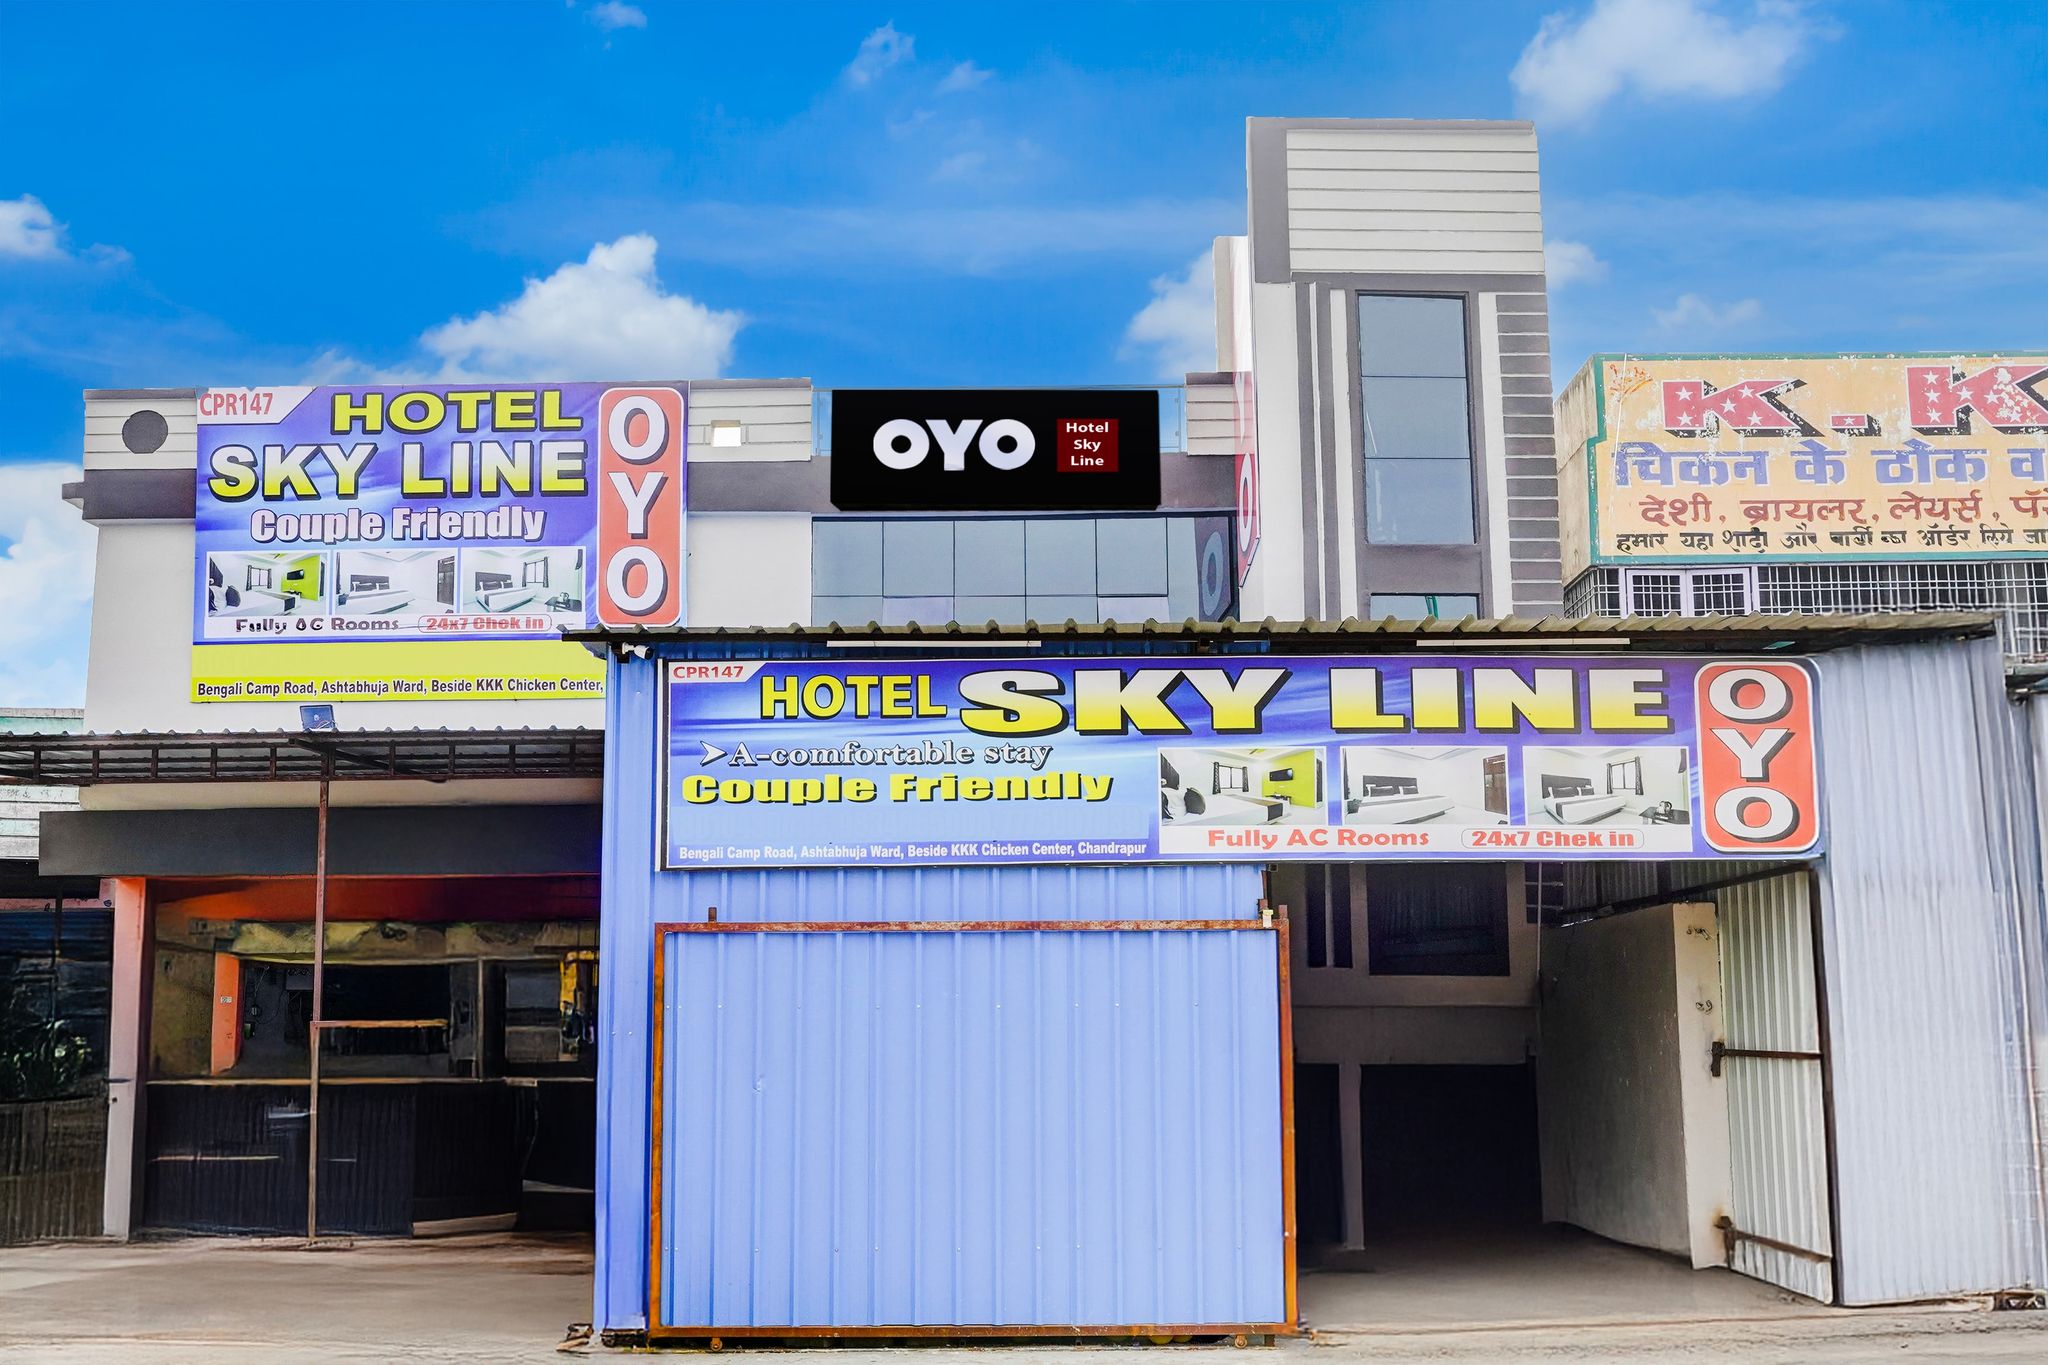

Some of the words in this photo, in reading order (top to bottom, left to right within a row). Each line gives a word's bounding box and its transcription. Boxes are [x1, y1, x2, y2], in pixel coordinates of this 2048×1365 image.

[199, 393, 274, 417] CPR147
[331, 389, 584, 435] HOTEL
[1066, 421, 1109, 433] Hotel
[873, 419, 1036, 471] OYO
[1073, 438, 1101, 452] Sky
[207, 441, 379, 502] SKY
[401, 440, 588, 499] LINE
[1070, 455, 1104, 466] Line
[1612, 441, 1770, 487] चिकन
[1790, 438, 1848, 485] के
[607, 395, 669, 619] OYO
[250, 507, 385, 545] Couple
[391, 504, 548, 541] Friendly
[331, 615, 400, 632] Rooms
[425, 616, 470, 632] 24x7
[472, 615, 521, 632] Chek
[524, 615, 545, 631] in
[672, 665, 745, 680] CPR147
[197, 682, 243, 698] Bengali
[246, 682, 281, 697] Camp
[284, 681, 318, 695] Road,
[321, 680, 390, 695] Ashtabhuja
[393, 679, 428, 694] Ward,
[431, 678, 473, 693] Beside
[476, 678, 504, 692] KKK
[507, 678, 557, 692] Chicken
[560, 677, 604, 693] Center,
[760, 673, 949, 720] HOTEL
[959, 667, 1293, 736] SKY
[1330, 667, 1675, 735] LINE
[728, 741, 975, 769] A-comfortable
[984, 742, 1054, 770] stay
[1708, 668, 1800, 842] OYO
[681, 774, 878, 805] Couple
[889, 773, 1113, 804] Friendly
[1207, 828, 1278, 850] Fully
[1286, 828, 1328, 846] AC
[1337, 828, 1430, 846] Rooms
[1471, 829, 1531, 847] 24x7
[1536, 829, 1606, 847] Chek
[1609, 829, 1636, 847] in
[679, 846, 725, 860] Bengali
[727, 846, 762, 860] Camp
[764, 845, 798, 860] Road,
[800, 844, 868, 860] Ashtabhuja
[870, 843, 905, 859] Ward,
[908, 843, 949, 857] Beside
[951, 843, 979, 857] KKK
[982, 842, 1030, 857] Chicken
[1032, 842, 1076, 858] Center,
[1077, 841, 1147, 858] Chandrapur
